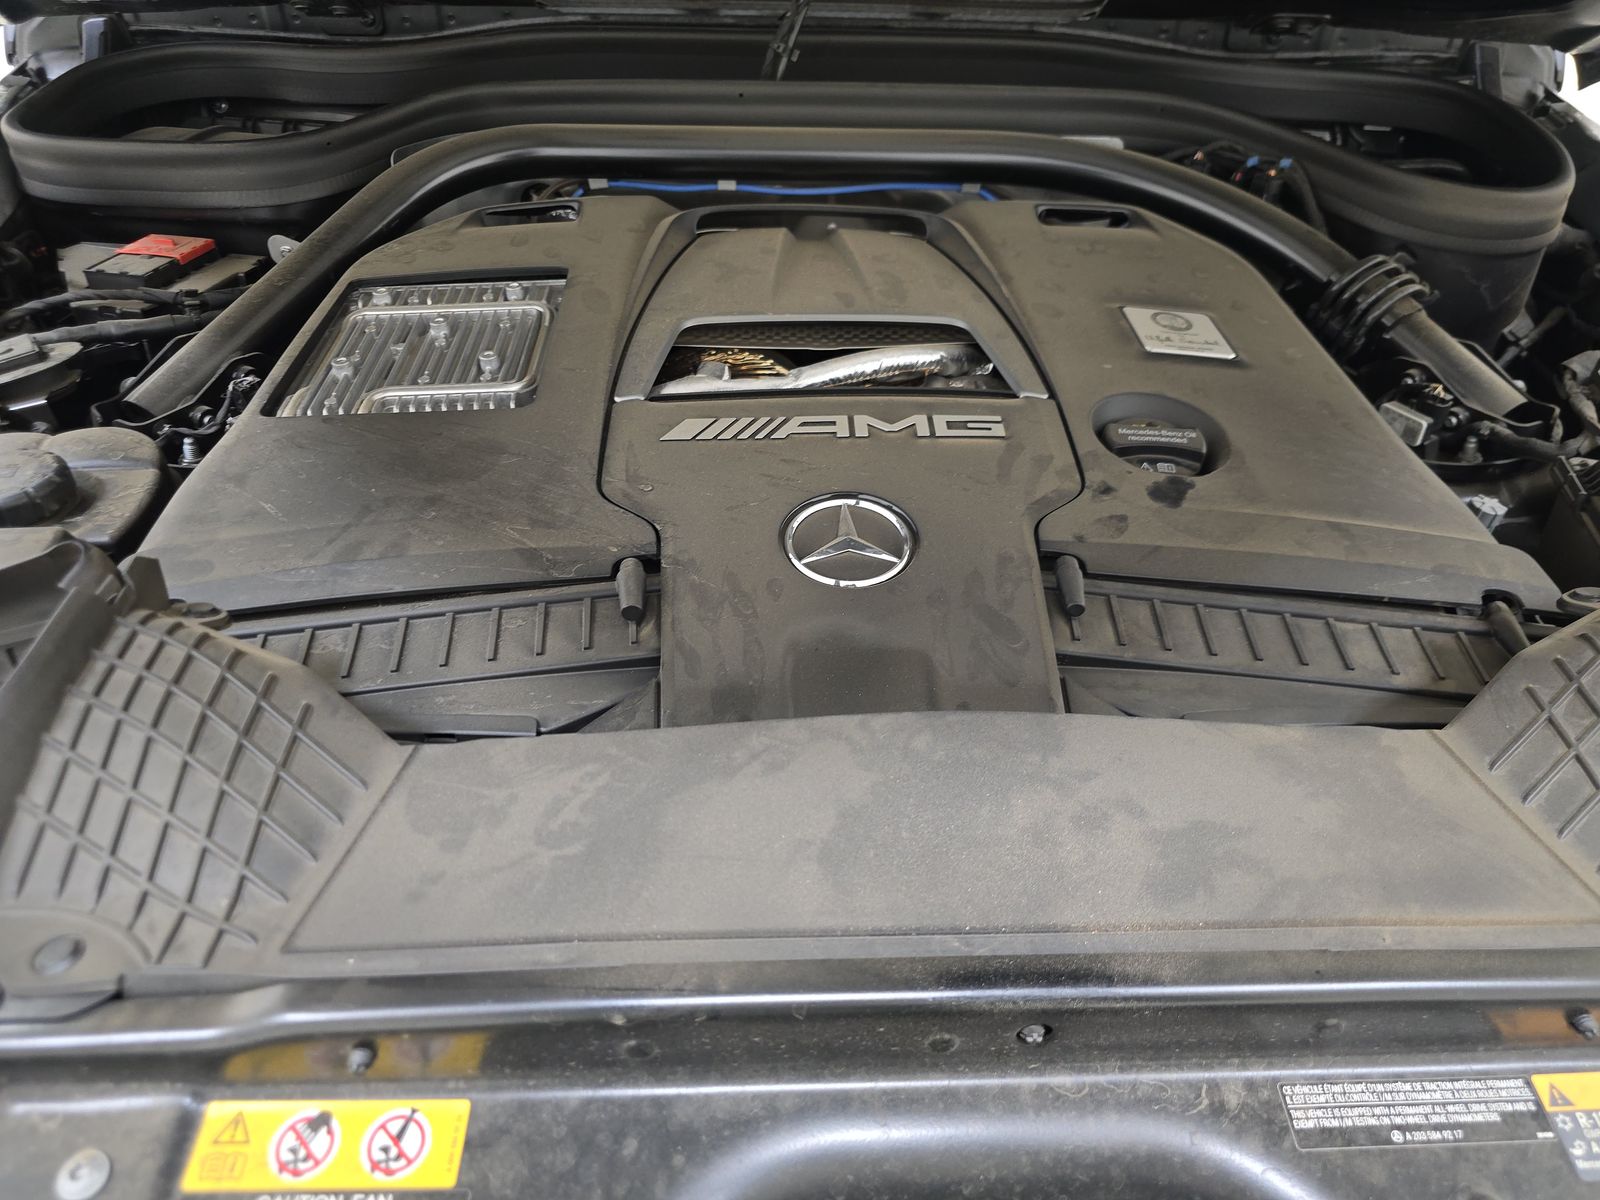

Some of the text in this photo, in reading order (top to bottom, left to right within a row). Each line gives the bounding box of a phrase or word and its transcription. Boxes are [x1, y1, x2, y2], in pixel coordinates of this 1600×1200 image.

[770, 414, 1006, 439] AMG
[1118, 428, 1197, 438] Mercedes-Benz Oil
[1128, 435, 1188, 444] recommended
[1283, 1085, 1293, 1095] CE
[1291, 1084, 1324, 1094] VÉHICULE
[1323, 1083, 1344, 1093] ÉTANT
[1344, 1082, 1368, 1093] ÉQUIPÉ
[1384, 1081, 1413, 1091] SYSTÈME
[1412, 1082, 1423, 1091] DE
[1422, 1081, 1453, 1090] TRACTION
[1452, 1080, 1487, 1089] INTÉGRALE
[1286, 1095, 1293, 1104] IL
[1292, 1095, 1305, 1104] EST
[1334, 1093, 1345, 1102] DU
[1391, 1092, 1406, 1101] SUR
[1459, 1089, 1477, 1098] DEUX
[1476, 1089, 1499, 1098] ROUES
[1289, 1110, 1305, 1119] THIS
[1305, 1109, 1333, 1118] VEHICLE
[1333, 1108, 1341, 1117] IS
[1340, 1107, 1372, 1117] EQUIPPED
[1371, 1106, 1389, 1115] WITH
[1394, 1105, 1434, 1115] PERMANENT
[1434, 1104, 1469, 1113] ALL-WHEEL
[1467, 1103, 1488, 1112] DRIVE
[1487, 1102, 1513, 1112] SYSTEM
[1513, 1102, 1527, 1111] AND
[1526, 1101, 1536, 1111] IS
[1293, 1119, 1319, 1129] EXEMPT
[1319, 1118, 1339, 1128] FROM
[1352, 1116, 1379, 1126] TESTING
[1379, 1116, 1390, 1125] ON
[1389, 1114, 1428, 1125] TWO-WHEEL
[1428, 1114, 1448, 1123] DRIVE
[1406, 1131, 1412, 1140] A
[1412, 1131, 1427, 1140] 203
[1442, 1130, 1453, 1139] 92
[1453, 1129, 1464, 1139] 17
